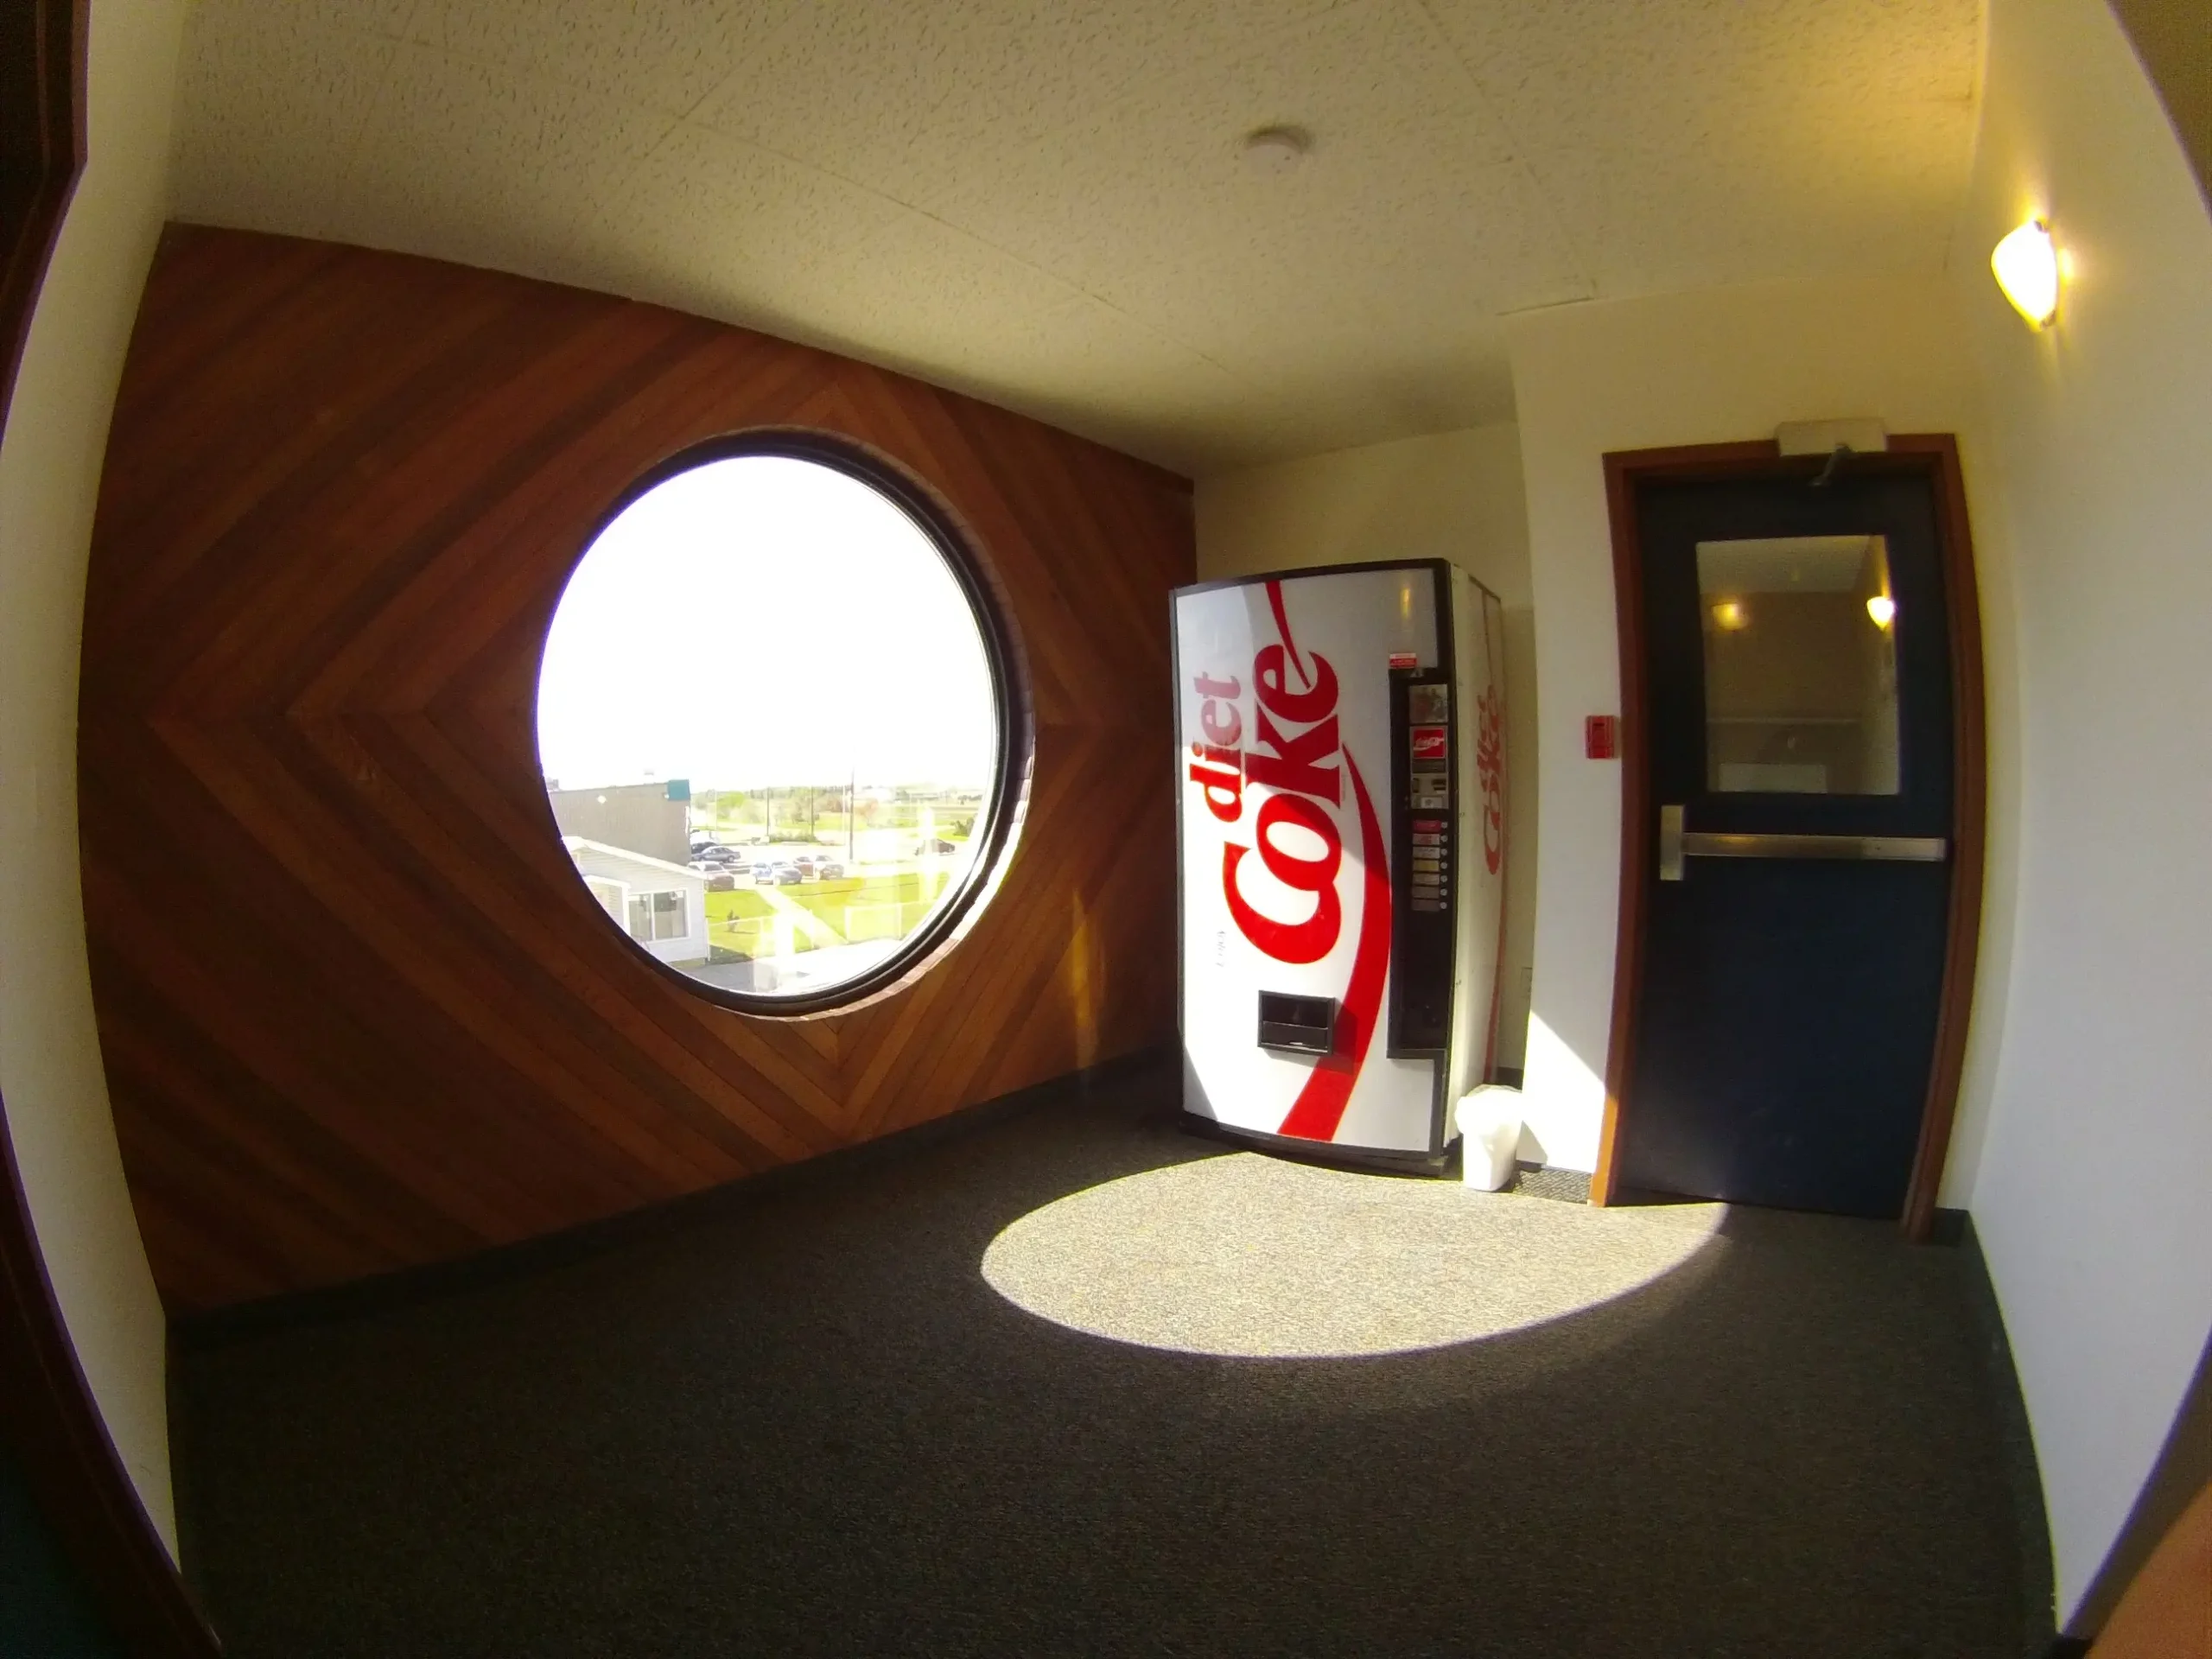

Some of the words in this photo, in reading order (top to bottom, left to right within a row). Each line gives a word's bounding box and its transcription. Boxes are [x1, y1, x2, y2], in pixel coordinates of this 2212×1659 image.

[1190, 671, 1243, 823] diet
[1223, 644, 1341, 964] Coke
[1483, 684, 1501, 875] Coke
